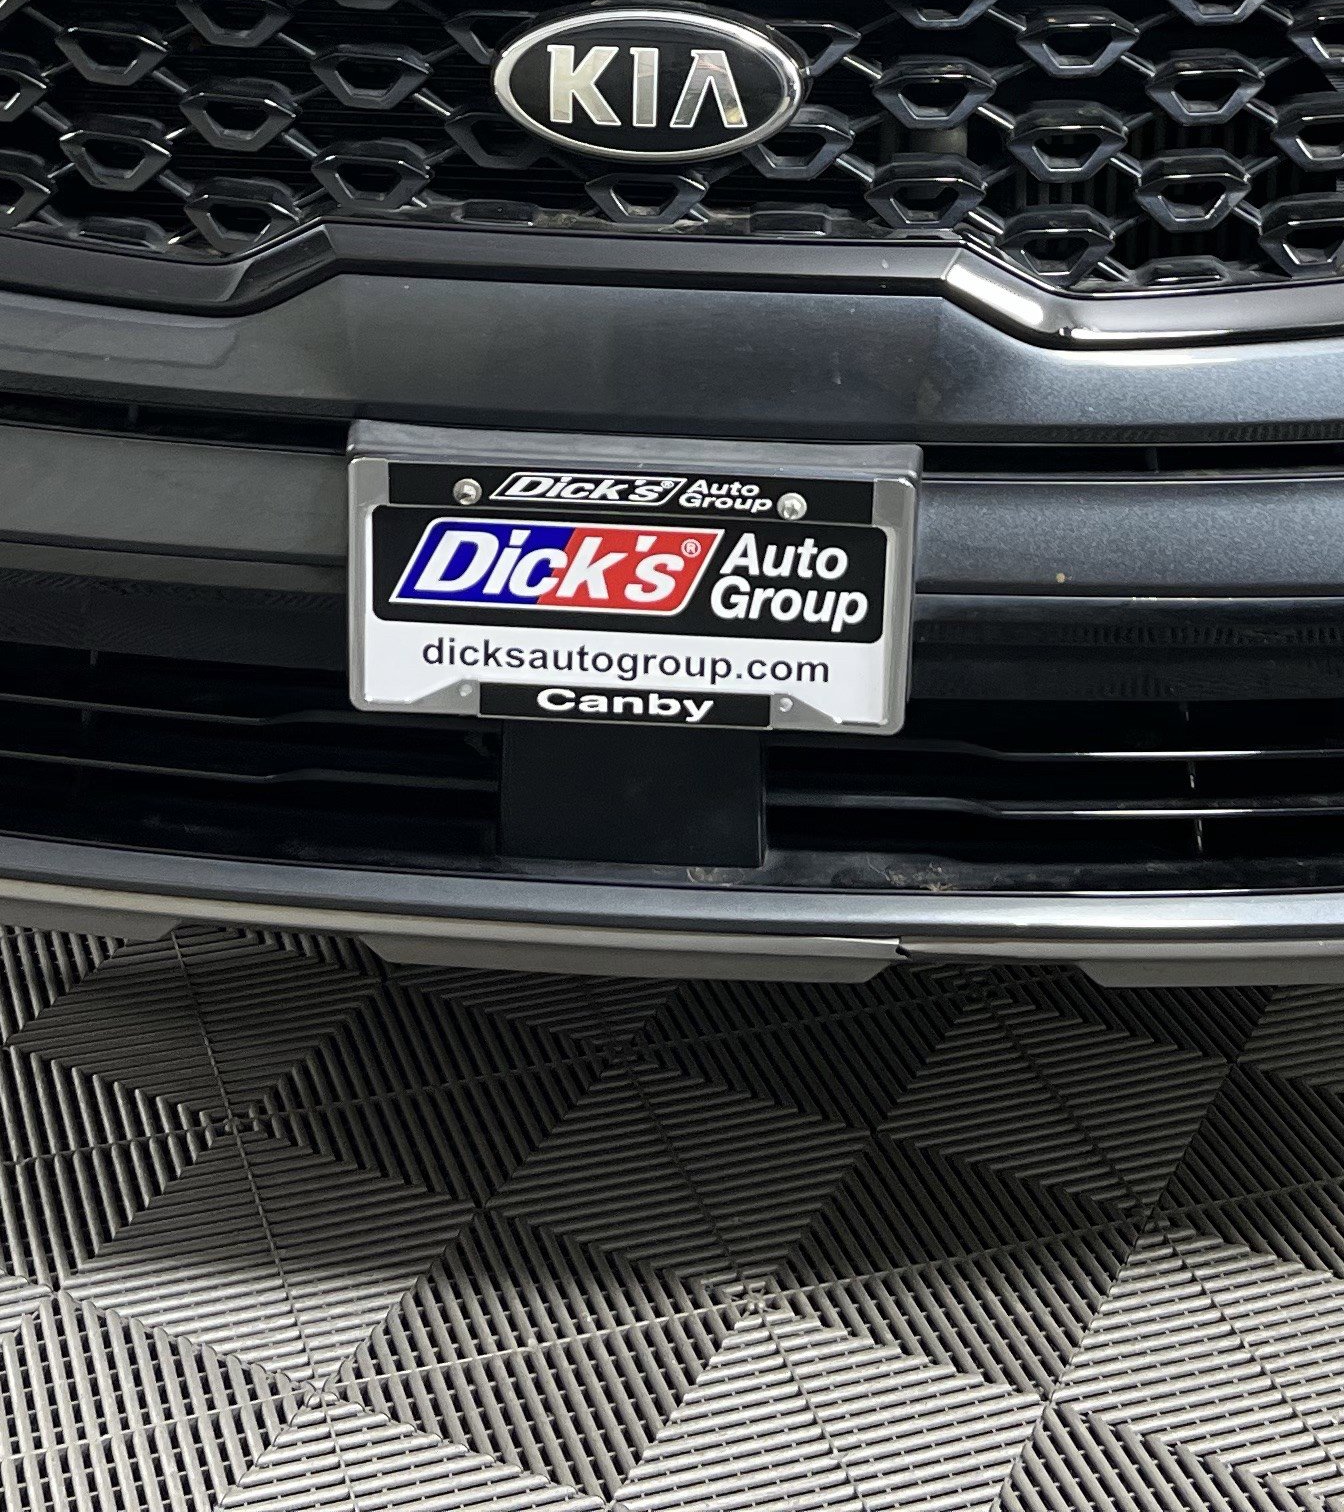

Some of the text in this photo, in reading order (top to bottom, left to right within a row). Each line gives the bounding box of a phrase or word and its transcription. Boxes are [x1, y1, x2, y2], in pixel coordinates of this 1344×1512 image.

[546, 44, 748, 129] KIA
[505, 475, 665, 502] Dick's
[678, 492, 773, 514] Group
[686, 478, 761, 497] Auto
[413, 528, 684, 604] Dick's
[719, 532, 849, 580] Auto
[709, 576, 869, 633] Group
[421, 637, 830, 685] dicksautogroup.com
[536, 687, 715, 723] Canby
